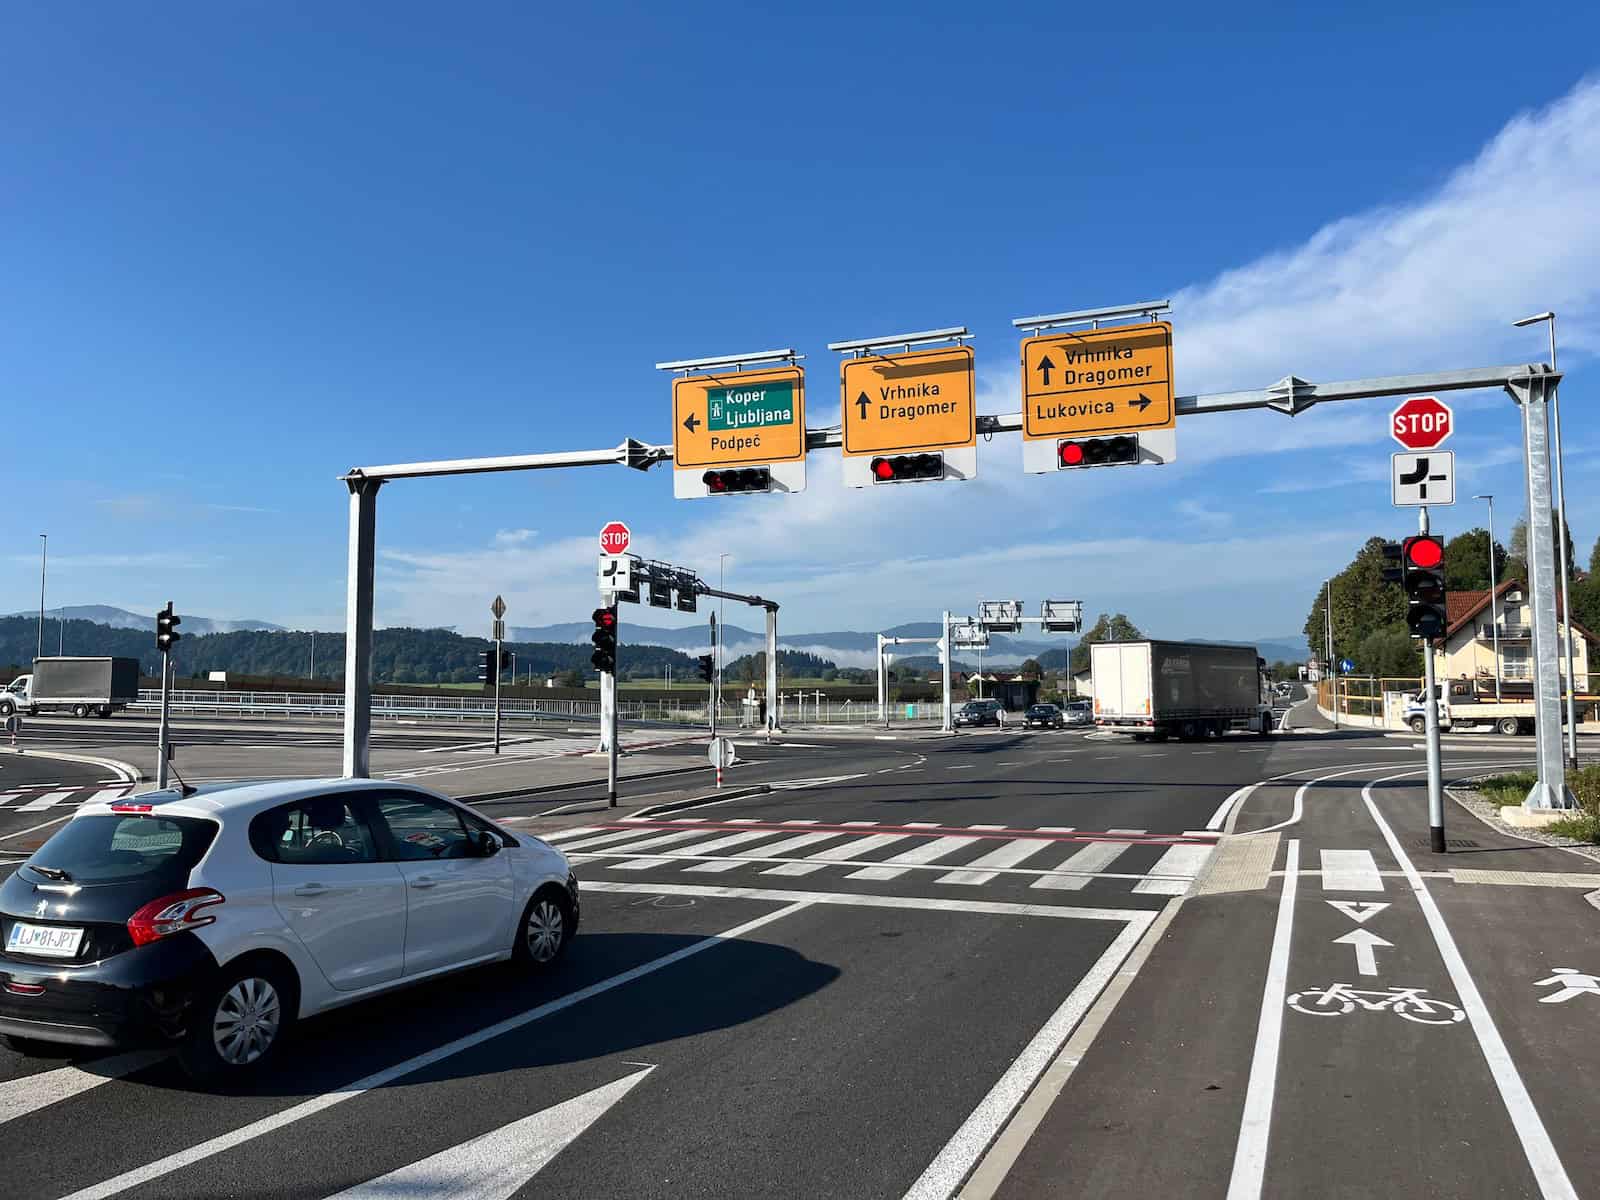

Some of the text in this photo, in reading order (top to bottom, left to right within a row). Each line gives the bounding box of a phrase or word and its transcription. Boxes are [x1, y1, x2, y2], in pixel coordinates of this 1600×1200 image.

[1065, 346, 1133, 365] Vrhnika
[1065, 365, 1152, 385] Dragomer
[726, 389, 766, 406] Koper
[880, 382, 940, 401] Vrhnika
[726, 408, 791, 428] Ljubljana
[880, 401, 957, 420] Dragomer
[1037, 400, 1114, 419] Lukovica
[1395, 412, 1447, 434] STOP
[711, 434, 760, 452] Podpeč
[602, 532, 628, 545] STOP
